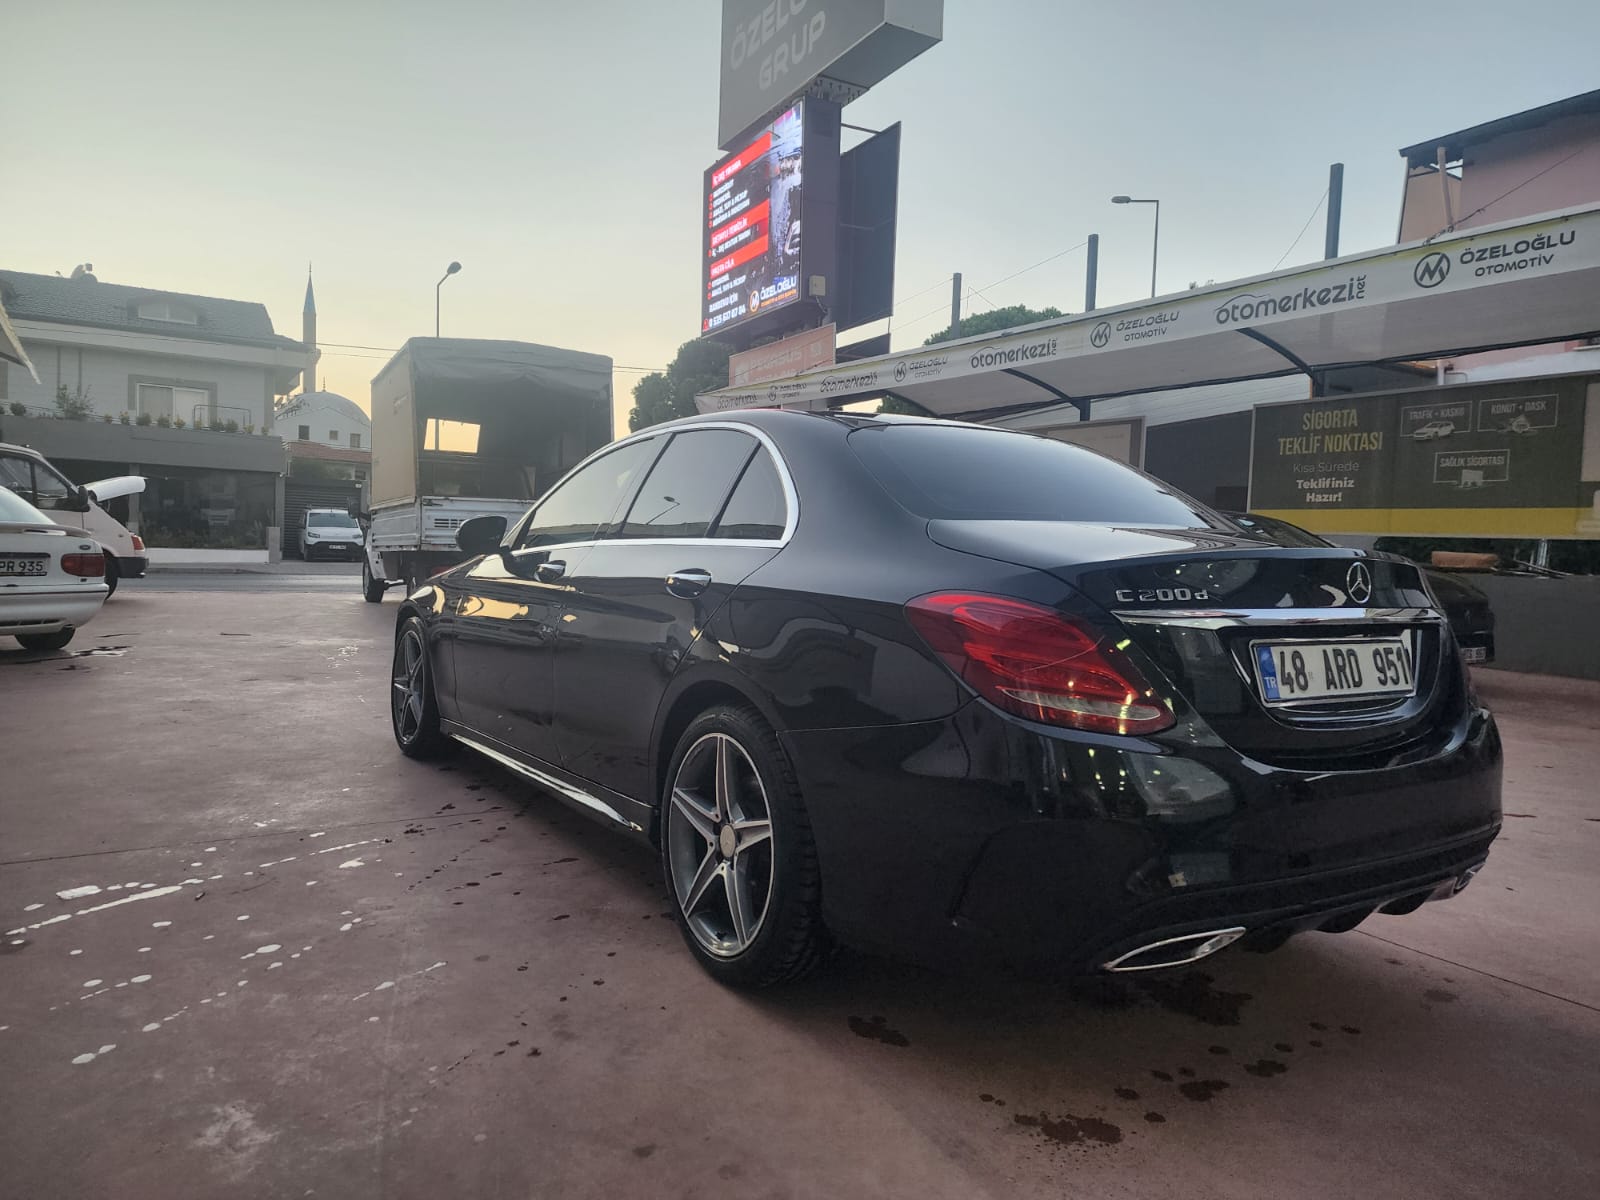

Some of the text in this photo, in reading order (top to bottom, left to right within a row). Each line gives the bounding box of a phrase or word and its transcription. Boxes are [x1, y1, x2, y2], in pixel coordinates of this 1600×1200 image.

[759, 11, 825, 91] GRUP
[1460, 230, 1576, 265] ÖZELOĞLU
[1474, 254, 1555, 277] OTOMOTİV
[760, 275, 798, 301] ÖZELOĞLU
[1116, 311, 1180, 332] ÖZELOĞLU
[1124, 327, 1168, 342] OTOMOTİV
[1302, 408, 1358, 431] SİGORTA
[1491, 403, 1516, 415] KONUT
[1278, 431, 1383, 455] TEKLİF NOKTASI
[1296, 477, 1355, 489] Teklifiniz
[18, 561, 44, 572] 935
[1115, 589, 1135, 602] C
[1280, 647, 1410, 693] 48 ARD 951
[1264, 676, 1277, 689] TR
